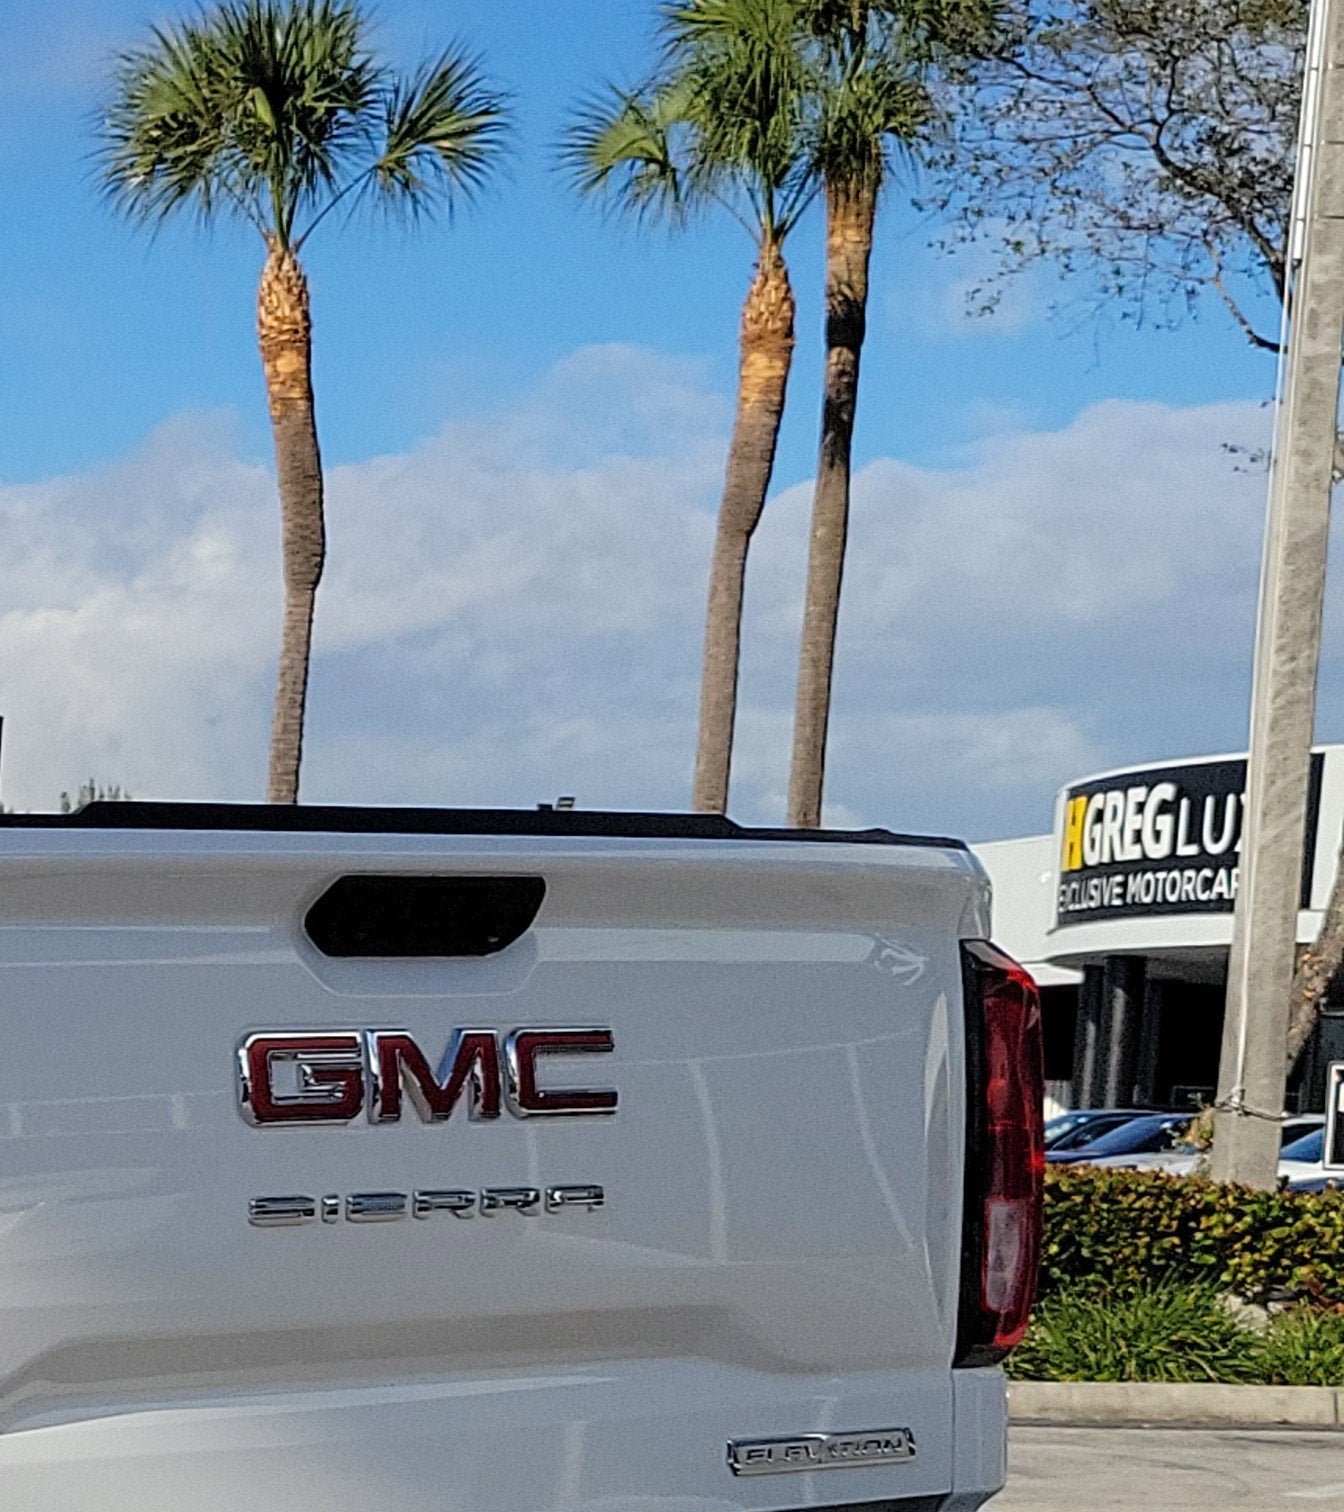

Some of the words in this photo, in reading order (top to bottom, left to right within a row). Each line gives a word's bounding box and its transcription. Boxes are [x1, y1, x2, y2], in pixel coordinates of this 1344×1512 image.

[1061, 782, 1247, 872] HGREGLU
[236, 1025, 618, 1127] GMC
[248, 1184, 604, 1227] SIERRA
